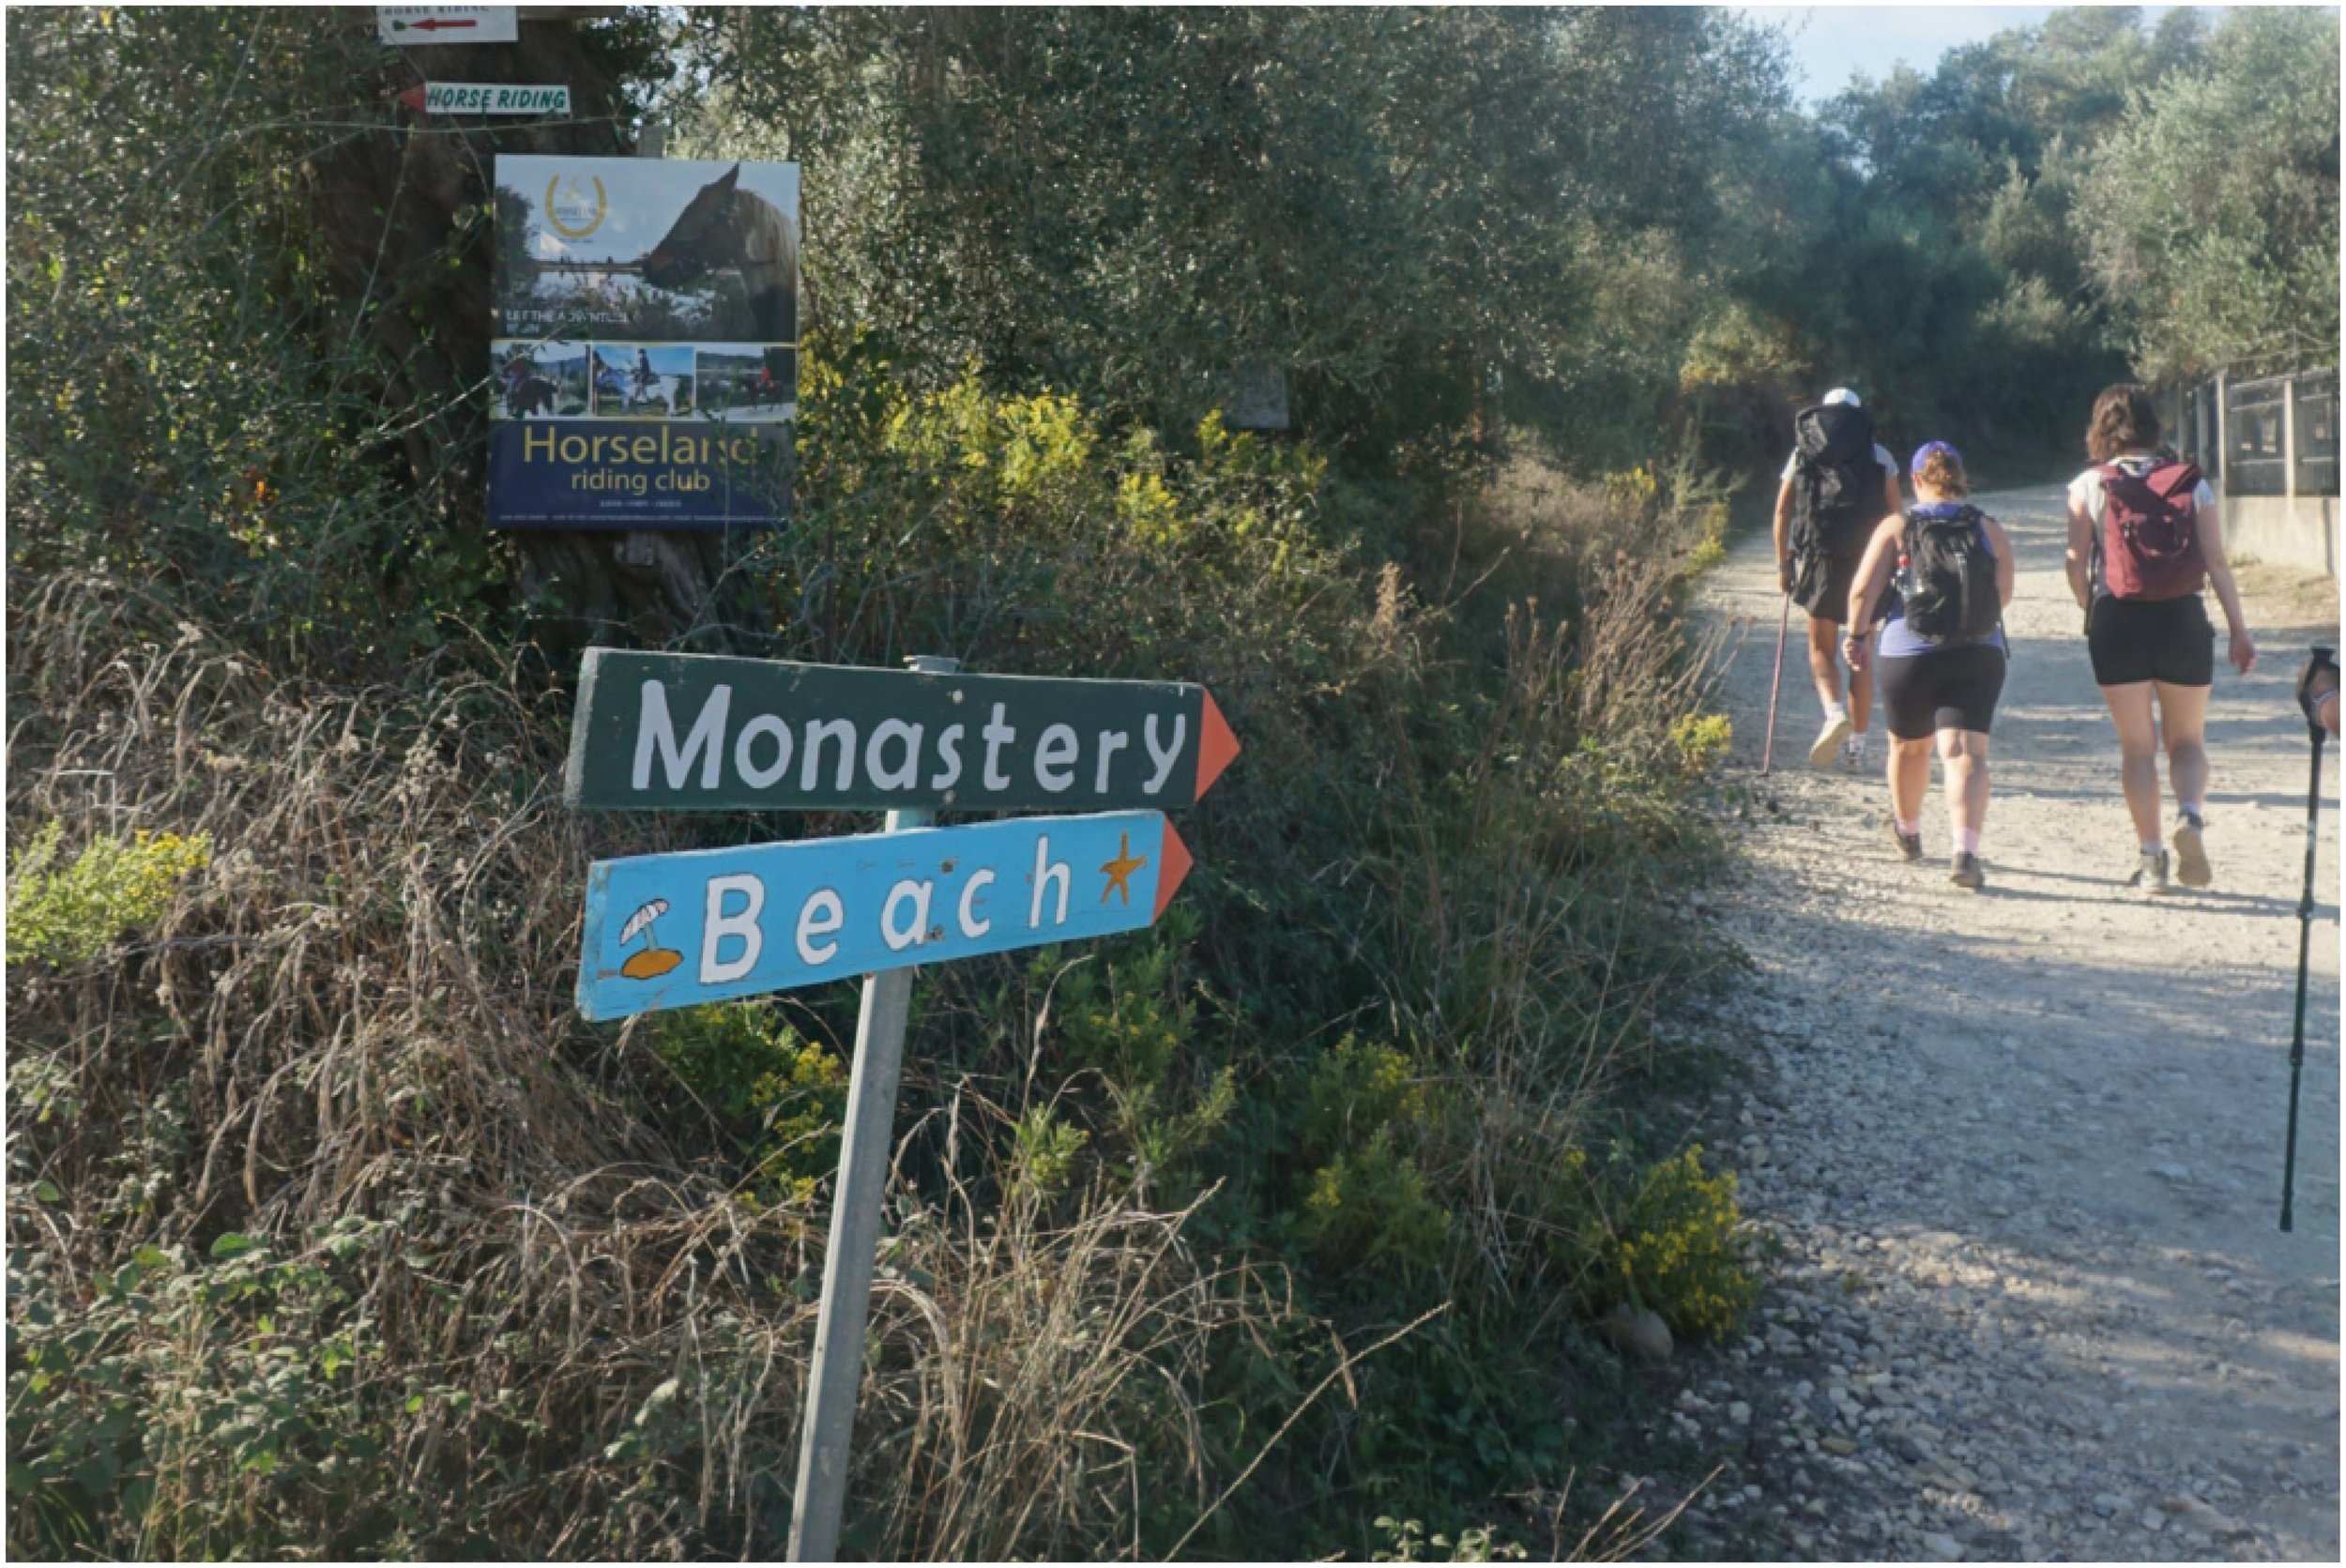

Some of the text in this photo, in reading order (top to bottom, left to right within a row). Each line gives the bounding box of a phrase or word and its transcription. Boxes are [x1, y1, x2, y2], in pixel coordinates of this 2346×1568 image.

[427, 86, 567, 109] HORSE RIDING
[571, 468, 711, 496] riding club
[632, 678, 1187, 795] Monastery
[698, 832, 1072, 984] Beach
